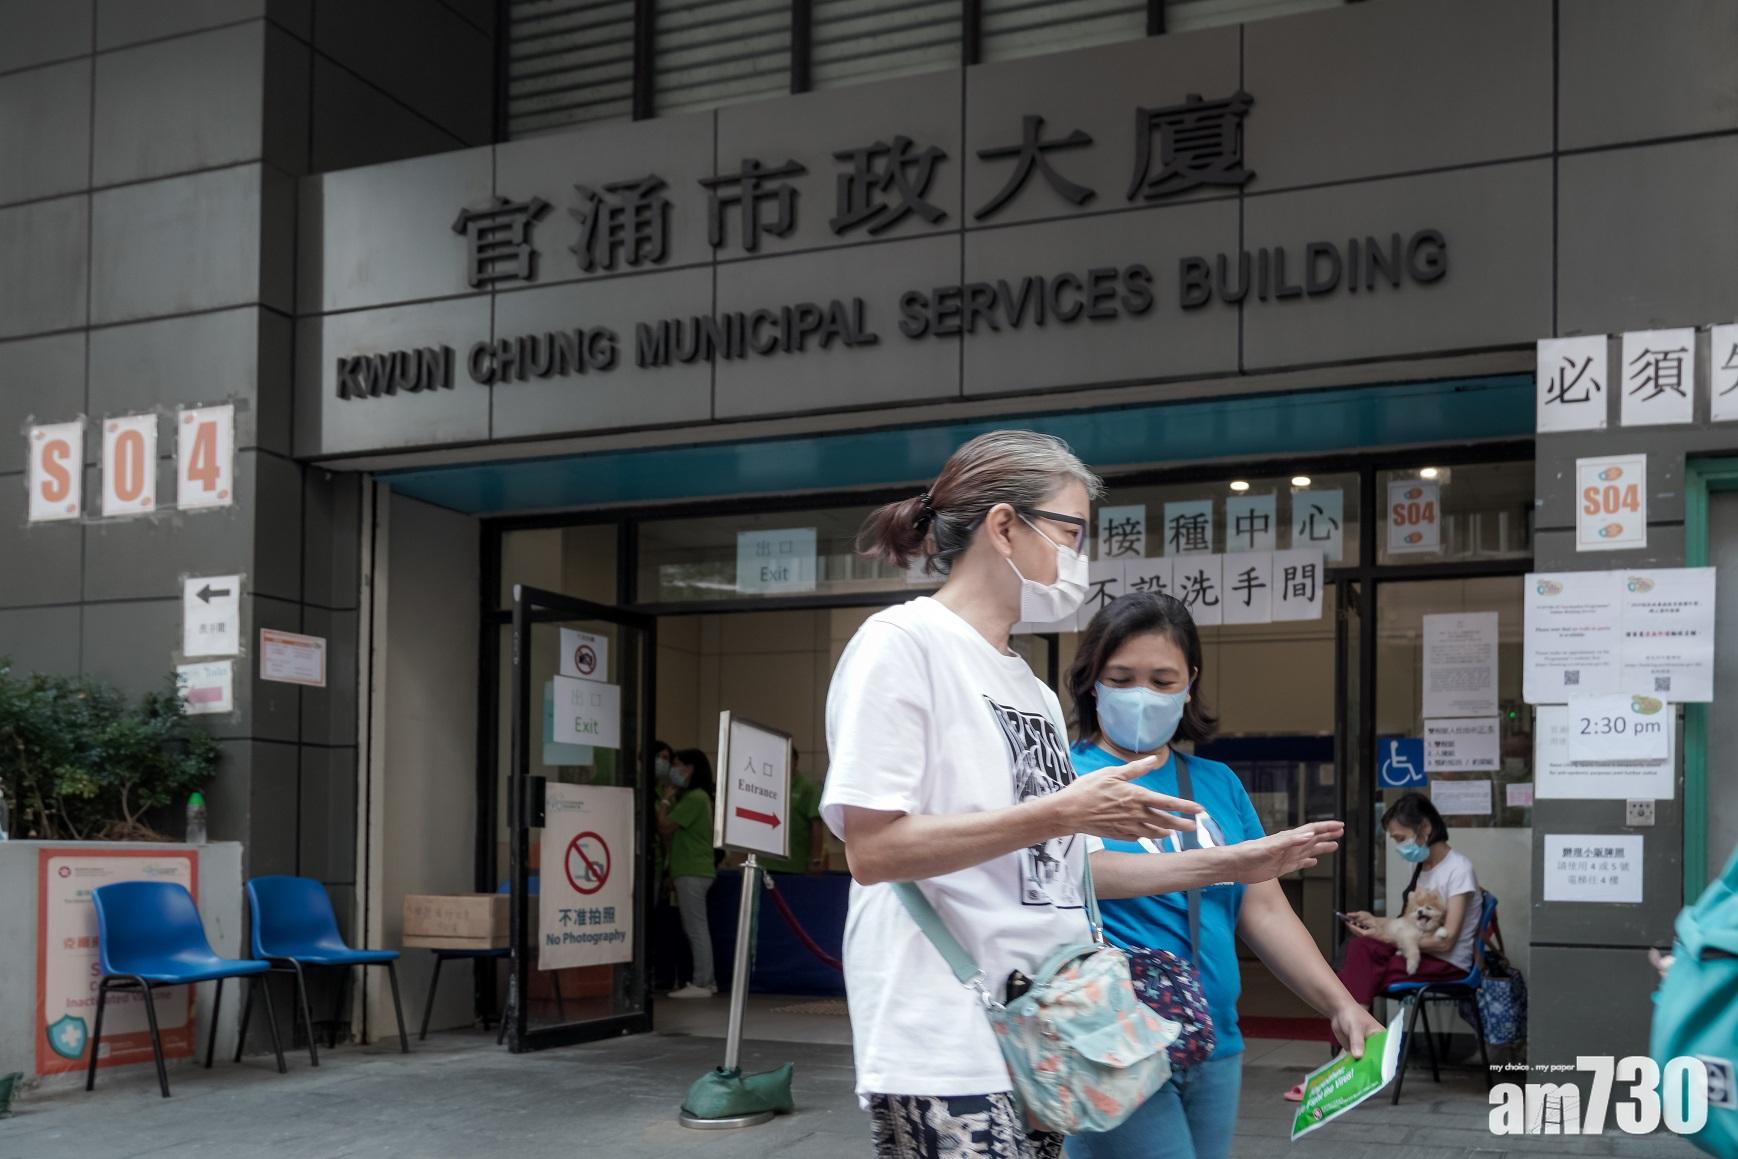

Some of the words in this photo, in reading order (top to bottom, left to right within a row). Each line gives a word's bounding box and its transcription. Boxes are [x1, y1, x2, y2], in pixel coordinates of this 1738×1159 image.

[451, 91, 1257, 289] 官涌市政大廈
[336, 345, 456, 401] KWUN
[469, 325, 620, 385] CHUNG
[635, 297, 880, 370] MUNICIPAL
[898, 263, 1154, 339] SERVICES
[1178, 228, 1449, 310] BUILDING
[1583, 483, 1641, 516] S04
[1392, 501, 1435, 528] S04
[1102, 503, 1339, 558] 接種中心
[755, 539, 793, 557] 出口
[760, 565, 789, 583] Exit
[570, 688, 602, 707] 出口
[574, 716, 599, 735] Exit
[1580, 716, 1626, 735] 2:30
[1634, 720, 1661, 736] pm
[743, 756, 774, 778] 入口
[738, 778, 778, 800] Entrance
[558, 906, 616, 927] 不准拍照
[546, 932, 561, 946] No
[563, 929, 626, 946] Photography
